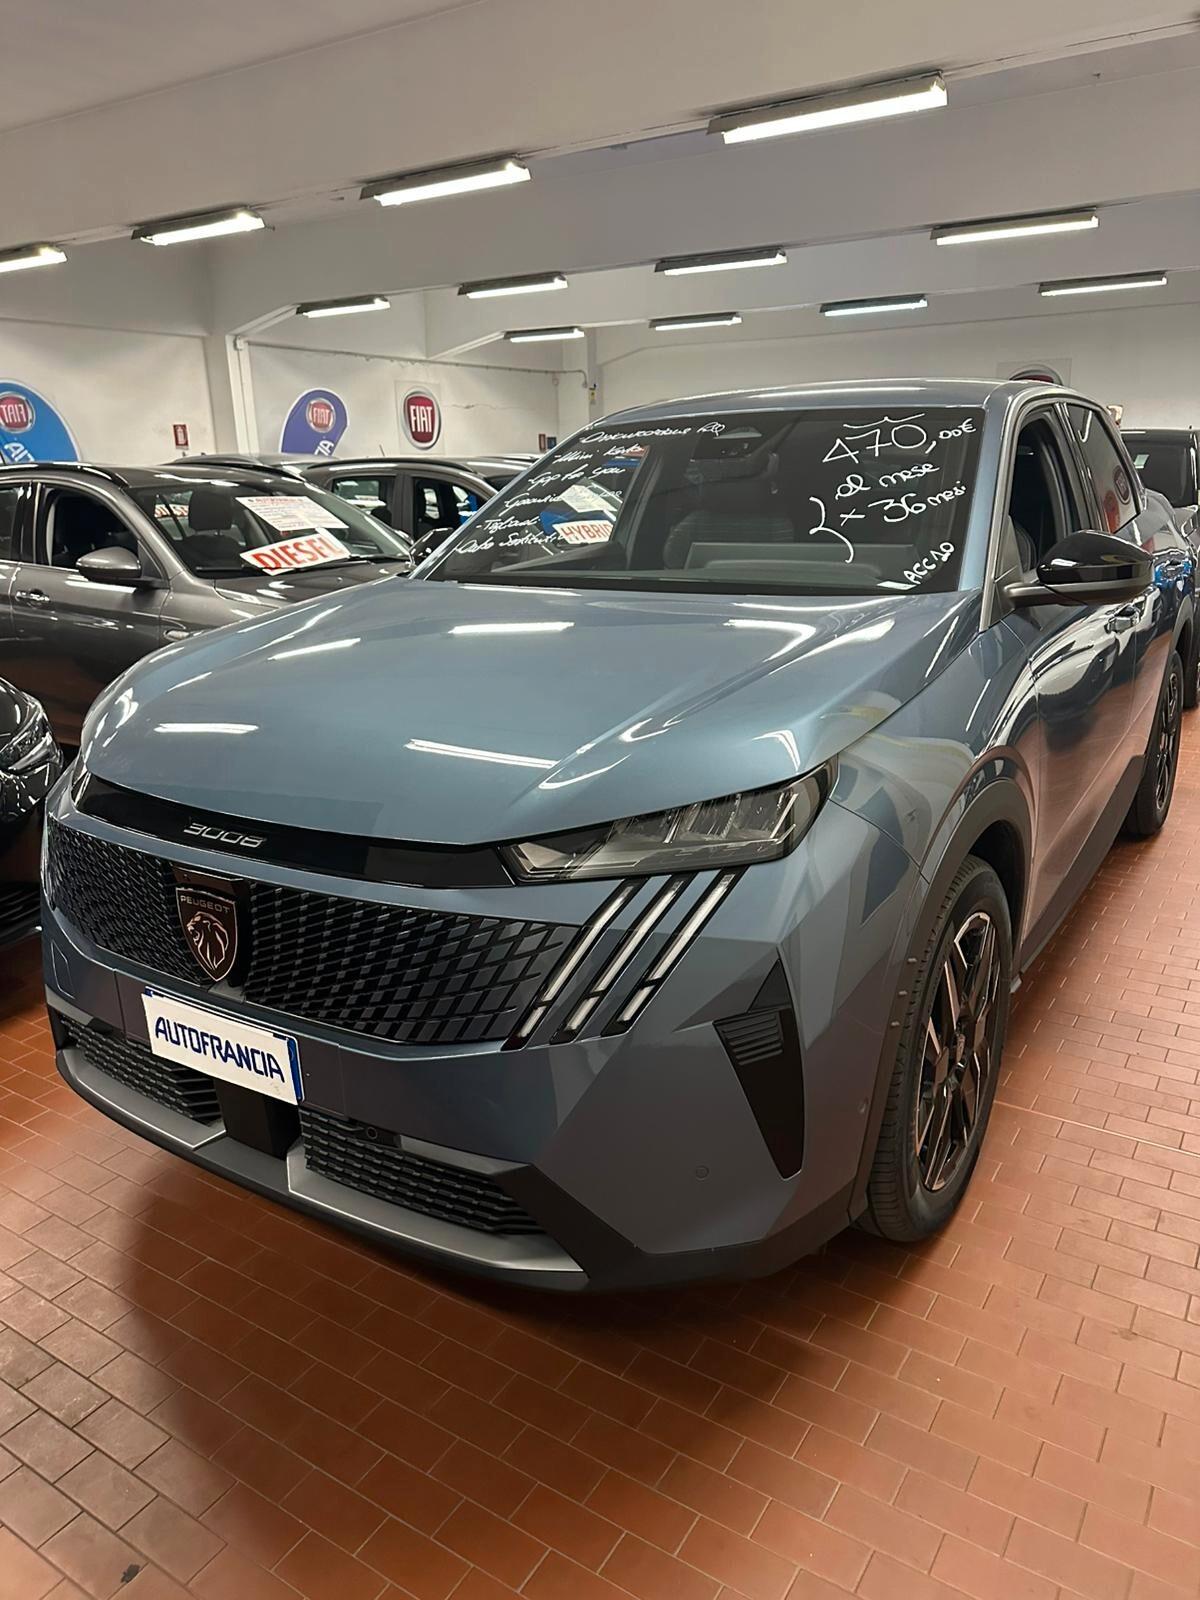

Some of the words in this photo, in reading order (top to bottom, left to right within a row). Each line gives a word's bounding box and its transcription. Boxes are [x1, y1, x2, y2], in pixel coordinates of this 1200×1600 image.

[312, 407, 330, 425] FIAT
[410, 405, 433, 433] FIAT
[867, 493, 927, 523] 36
[251, 536, 345, 571] DIESEL
[184, 822, 266, 848] 3008
[180, 894, 232, 913] PEUGEOT
[155, 1016, 286, 1083] AUTOFRANCIA
